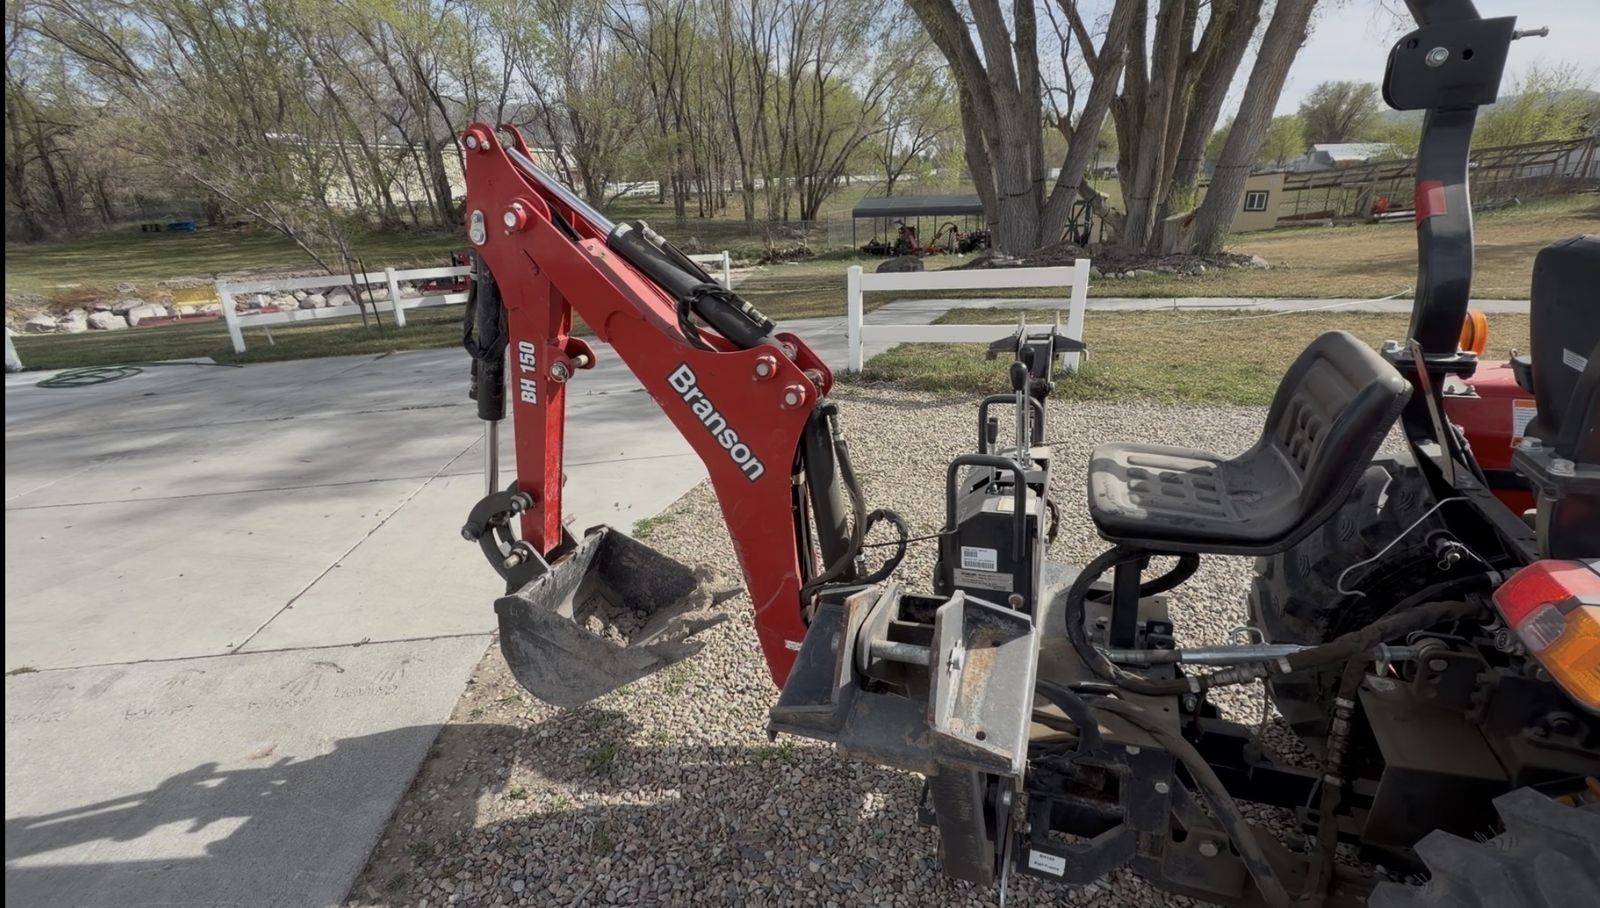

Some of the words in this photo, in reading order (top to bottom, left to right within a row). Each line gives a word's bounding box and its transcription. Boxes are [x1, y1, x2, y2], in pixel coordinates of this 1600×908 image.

[519, 341, 536, 373] 150
[520, 378, 537, 404] BH
[667, 363, 765, 481] Branson
